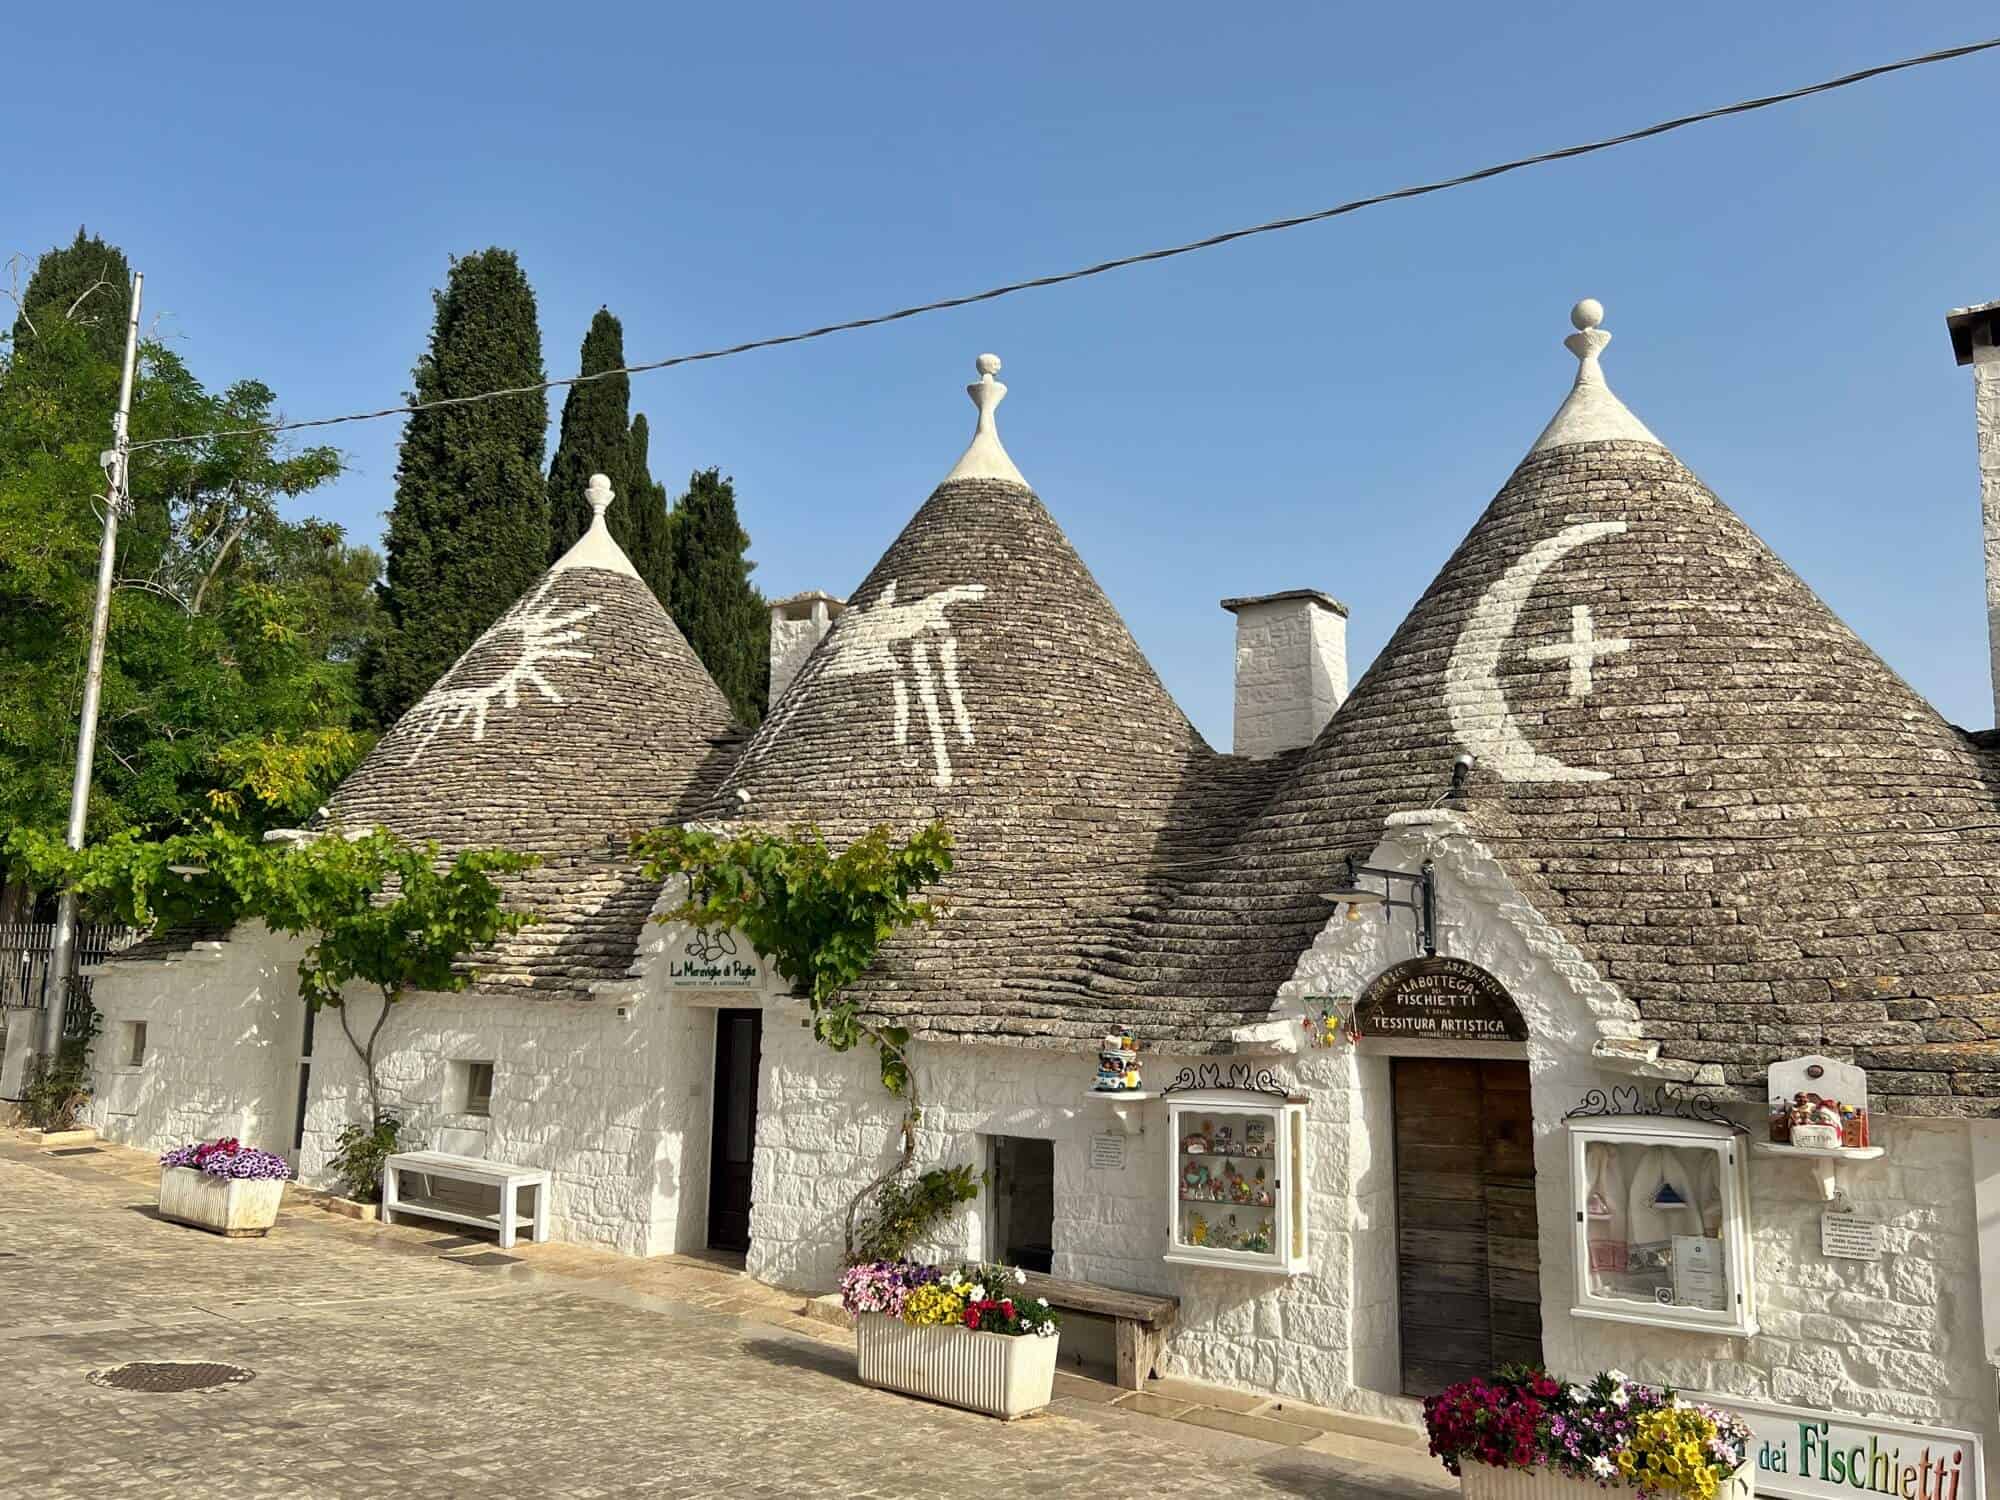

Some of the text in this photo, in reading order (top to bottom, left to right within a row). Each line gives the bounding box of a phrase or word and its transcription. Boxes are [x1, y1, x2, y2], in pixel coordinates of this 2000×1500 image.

[723, 964, 731, 977] di
[733, 960, 757, 980] Puglia
[1397, 994, 1476, 1008] FISCHIETTI
[1372, 1016, 1505, 1032] TESSITURA ARTISTICA
[1759, 1420, 1963, 1500] dei Fischietti
